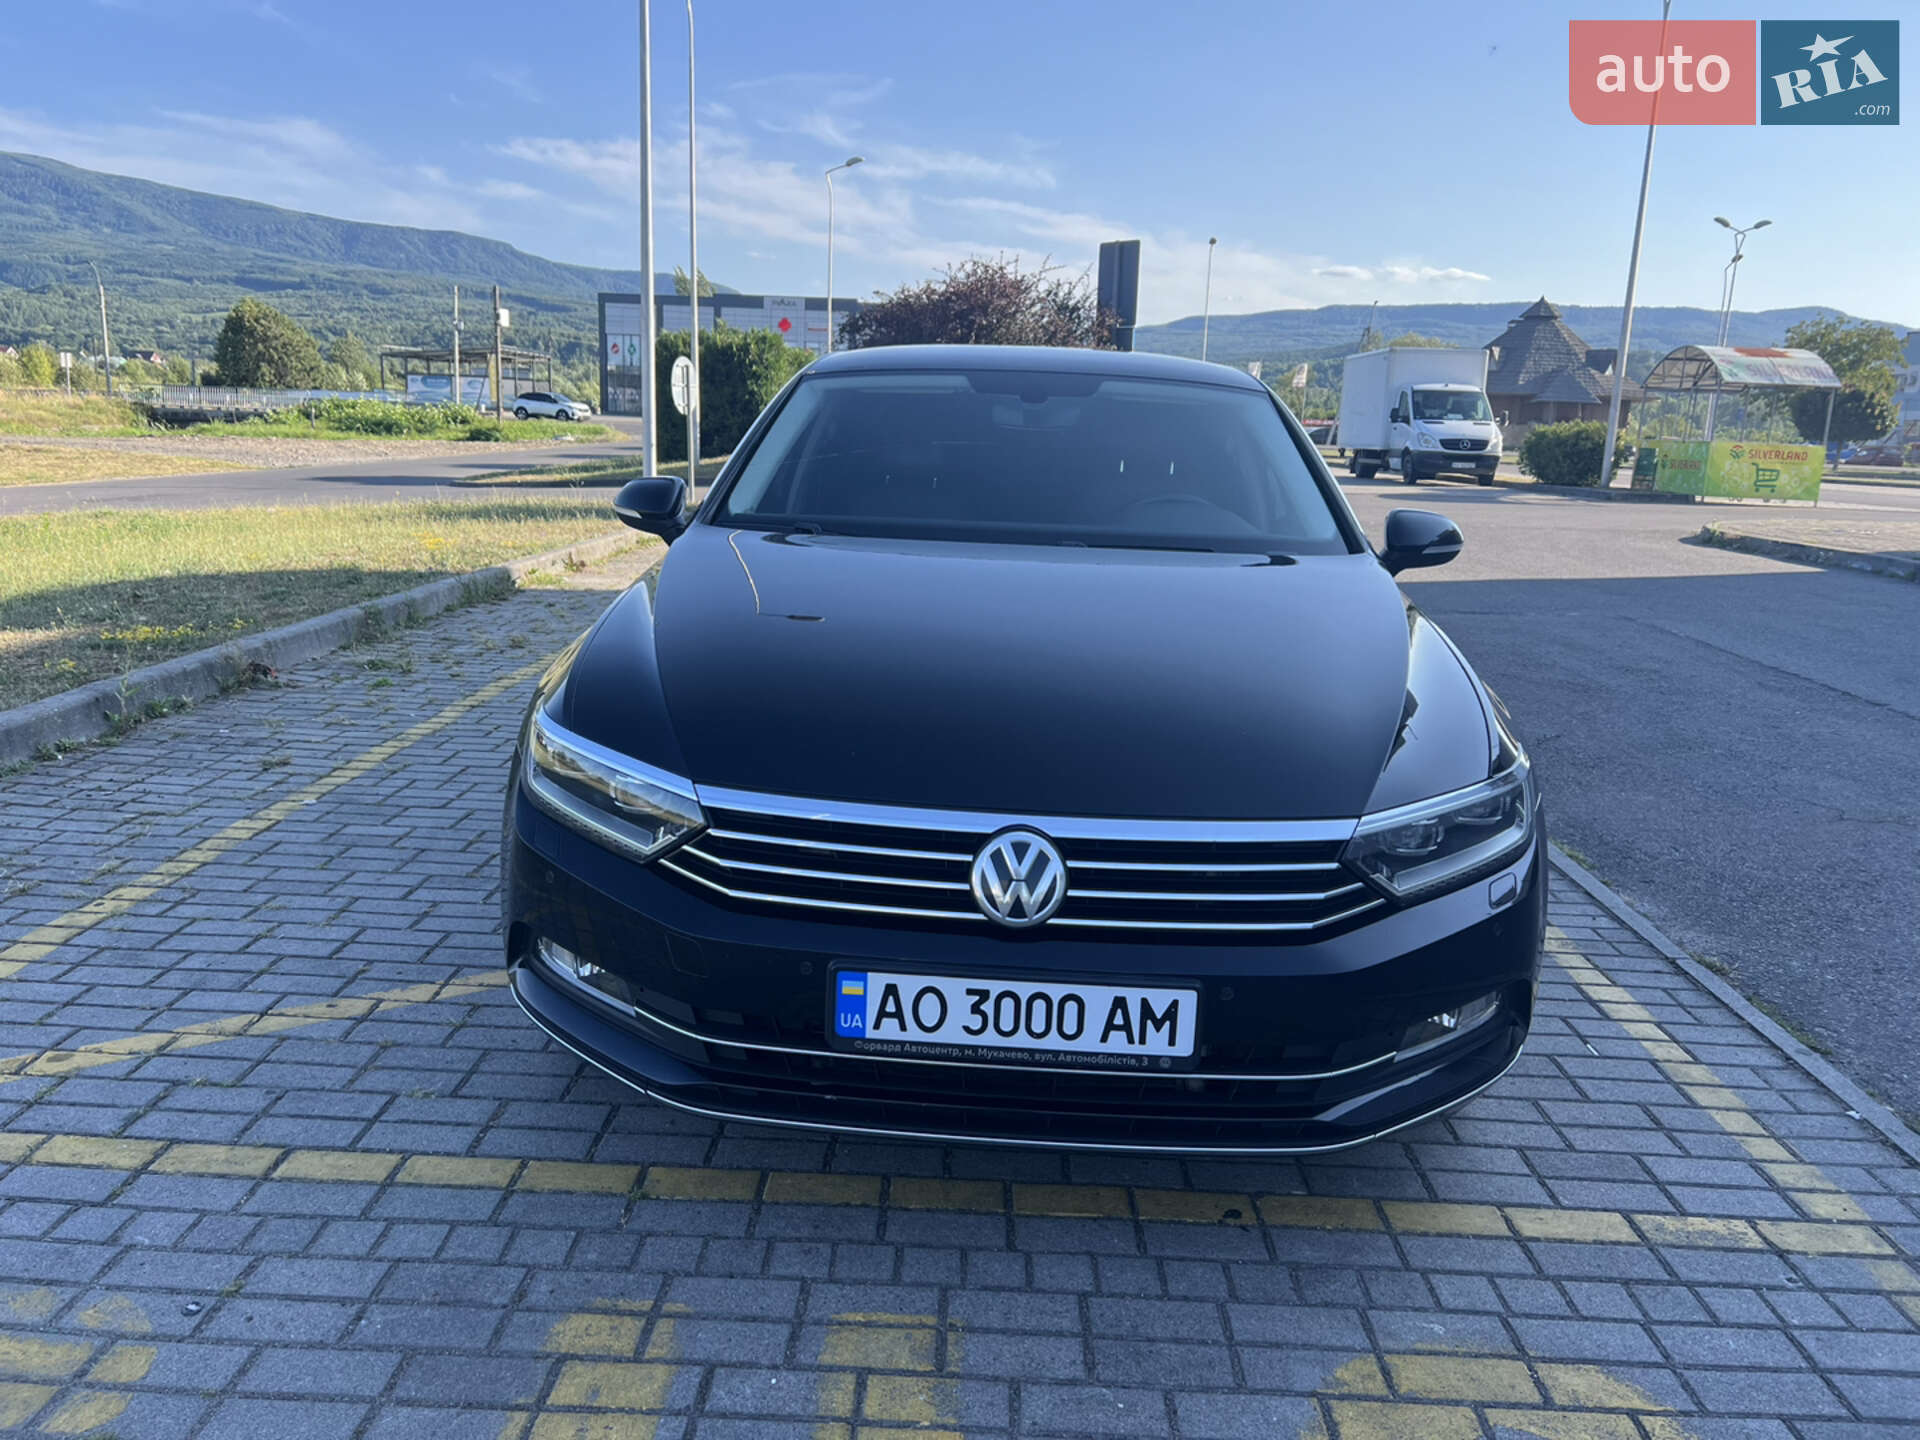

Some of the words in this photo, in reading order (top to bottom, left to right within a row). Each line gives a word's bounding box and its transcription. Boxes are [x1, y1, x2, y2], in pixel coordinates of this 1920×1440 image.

[1748, 448, 1809, 462] SILVERLAND
[840, 1012, 863, 1029] UA
[872, 983, 948, 1034] AO
[961, 988, 1086, 1041] 3000
[1100, 996, 1179, 1047] AM
[903, 1042, 962, 1057] Автоцентр,
[977, 1047, 1033, 1061] Мукачево,
[1034, 1051, 1056, 1063] вул.
[1058, 1052, 1139, 1067] Автомобілістів,
